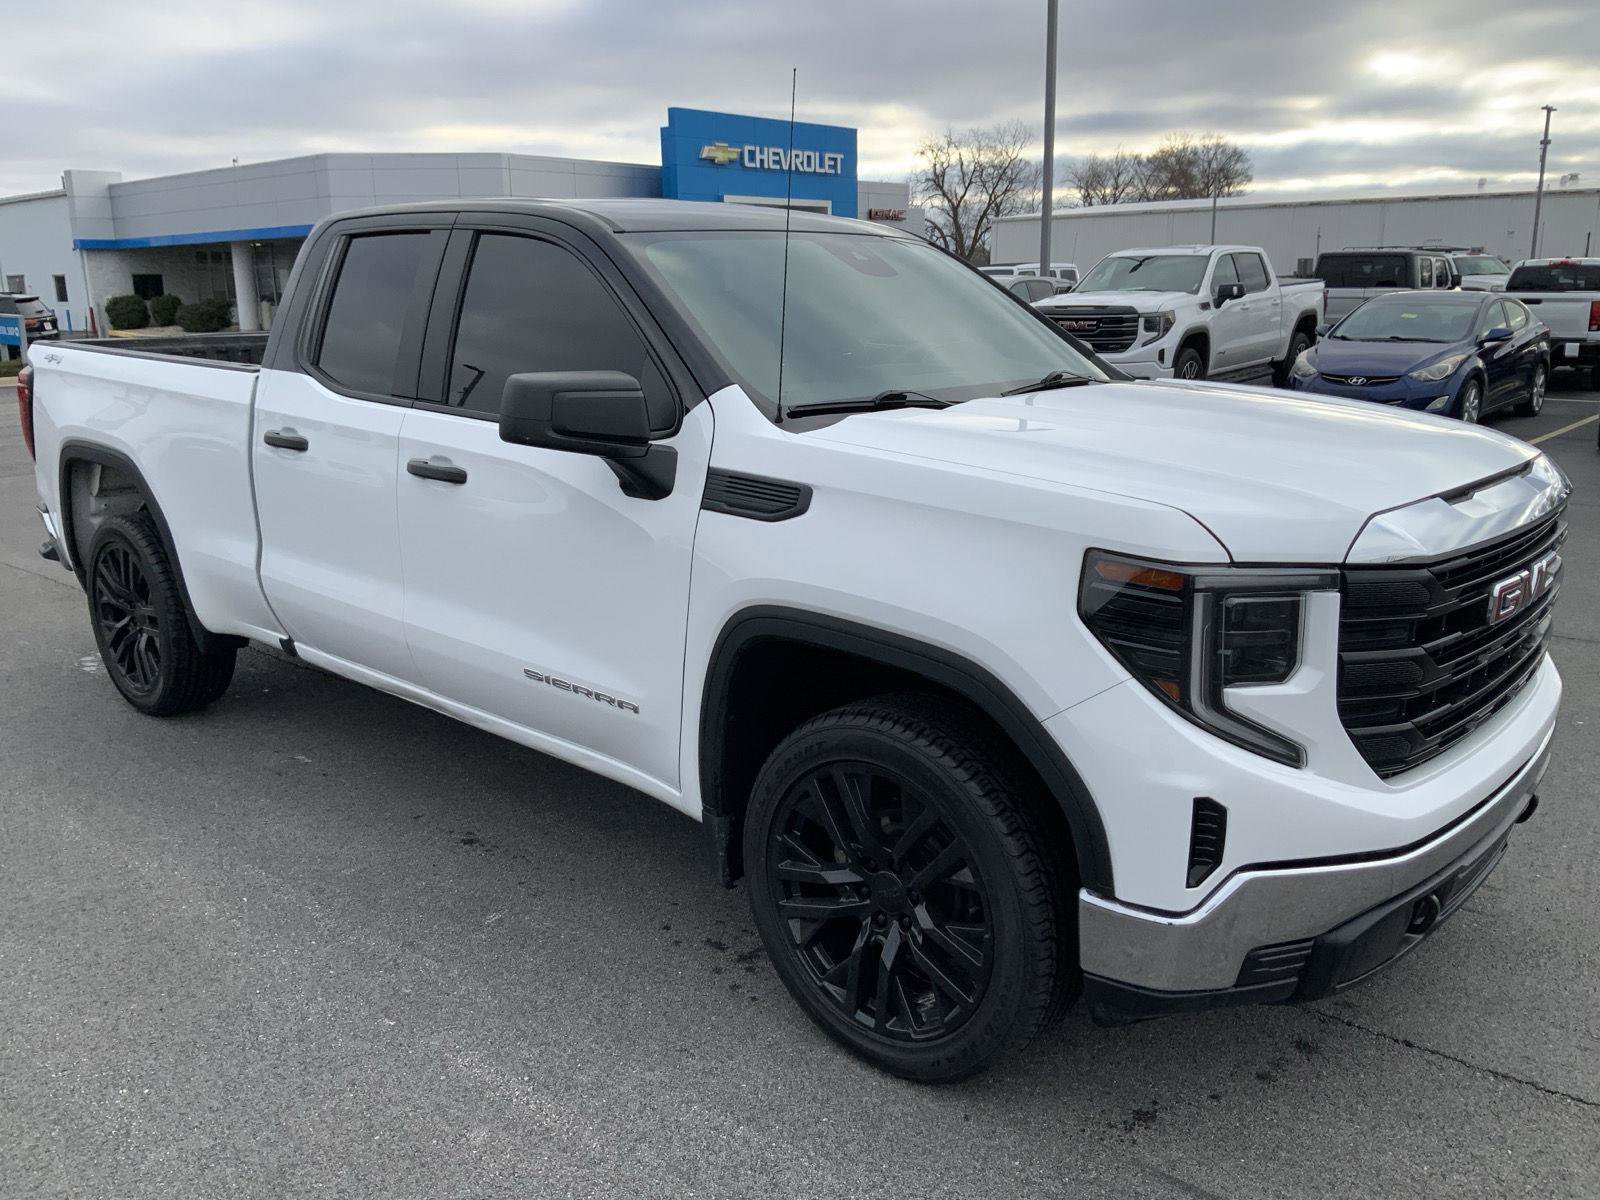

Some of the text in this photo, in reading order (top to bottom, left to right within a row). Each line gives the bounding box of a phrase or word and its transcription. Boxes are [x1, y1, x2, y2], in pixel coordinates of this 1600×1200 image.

[743, 144, 844, 175] CHEVROLET
[1490, 551, 1562, 625] GMC
[523, 667, 640, 715] SIERRA
